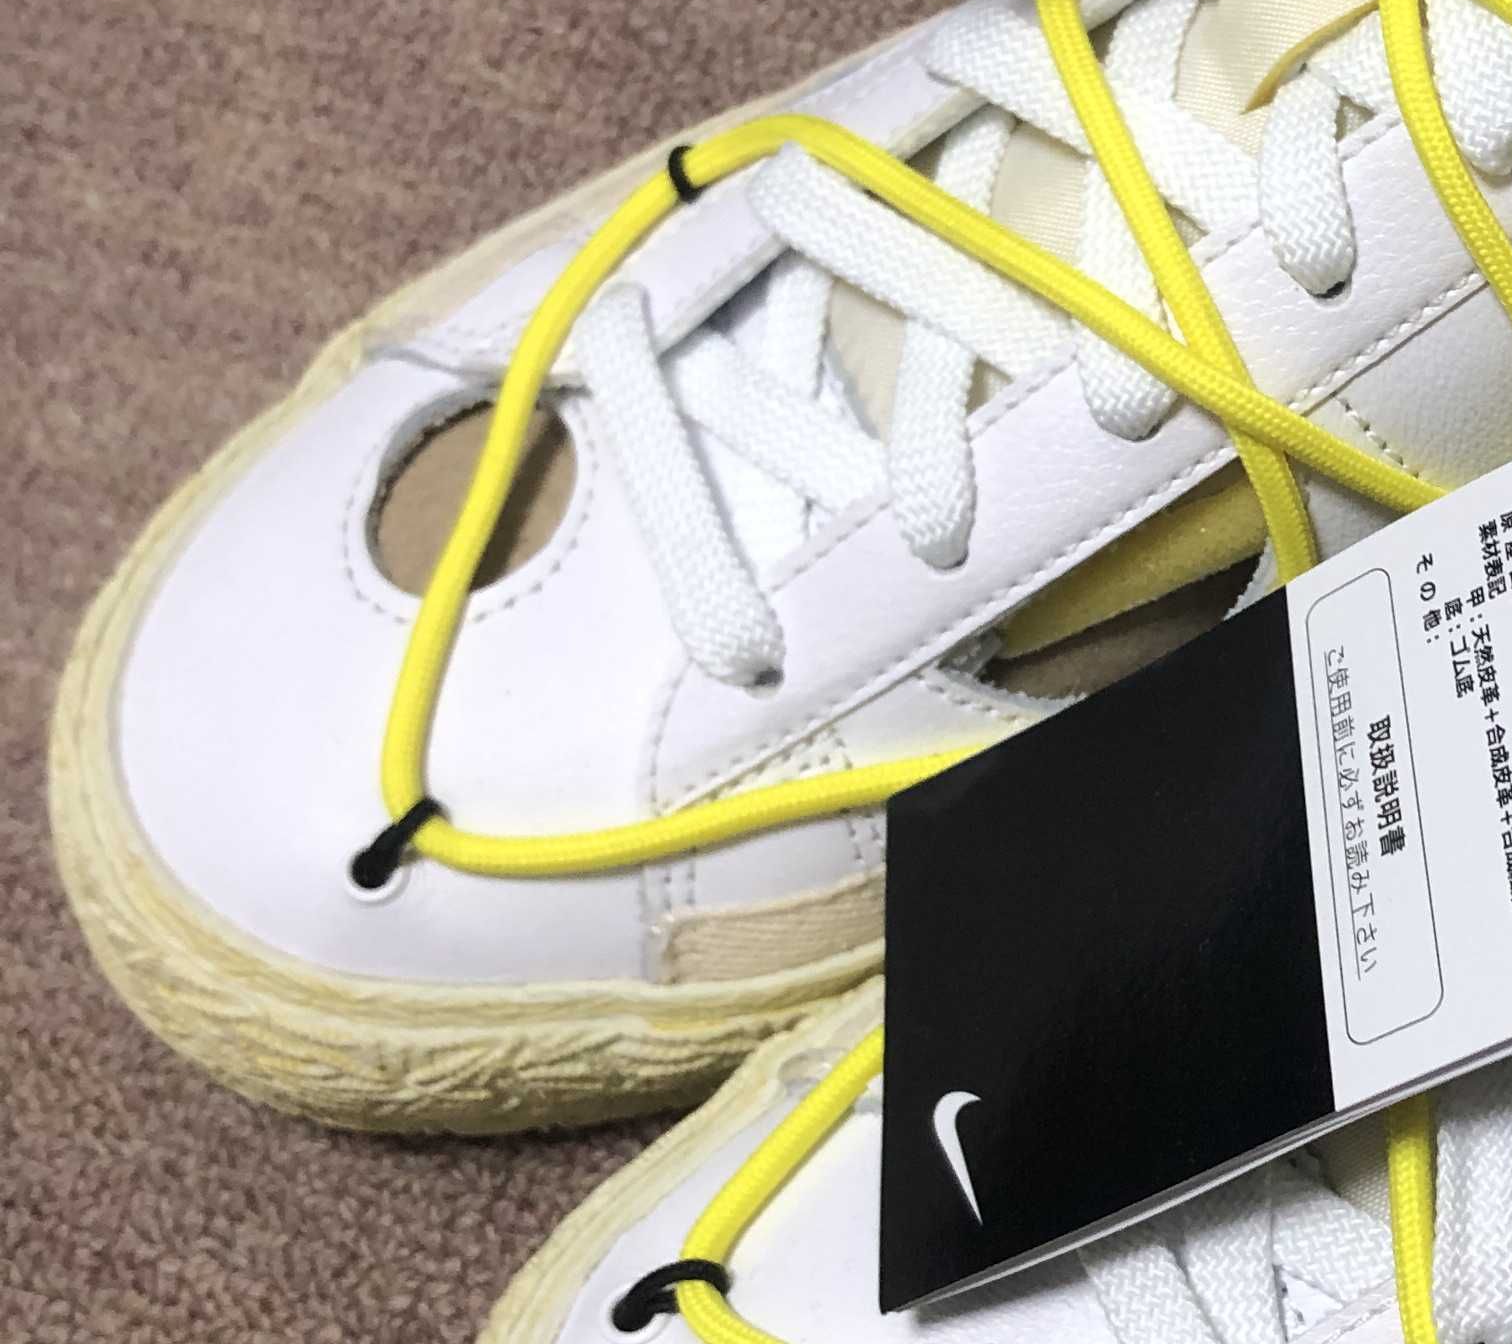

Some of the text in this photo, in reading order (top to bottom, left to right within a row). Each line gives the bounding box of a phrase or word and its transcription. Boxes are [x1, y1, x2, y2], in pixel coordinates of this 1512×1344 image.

[1479, 519, 1507, 600] 素材表記
[1324, 645, 1378, 974] ご使用前に必ずお読み下さい
[1367, 714, 1407, 857] 取扱説明書
